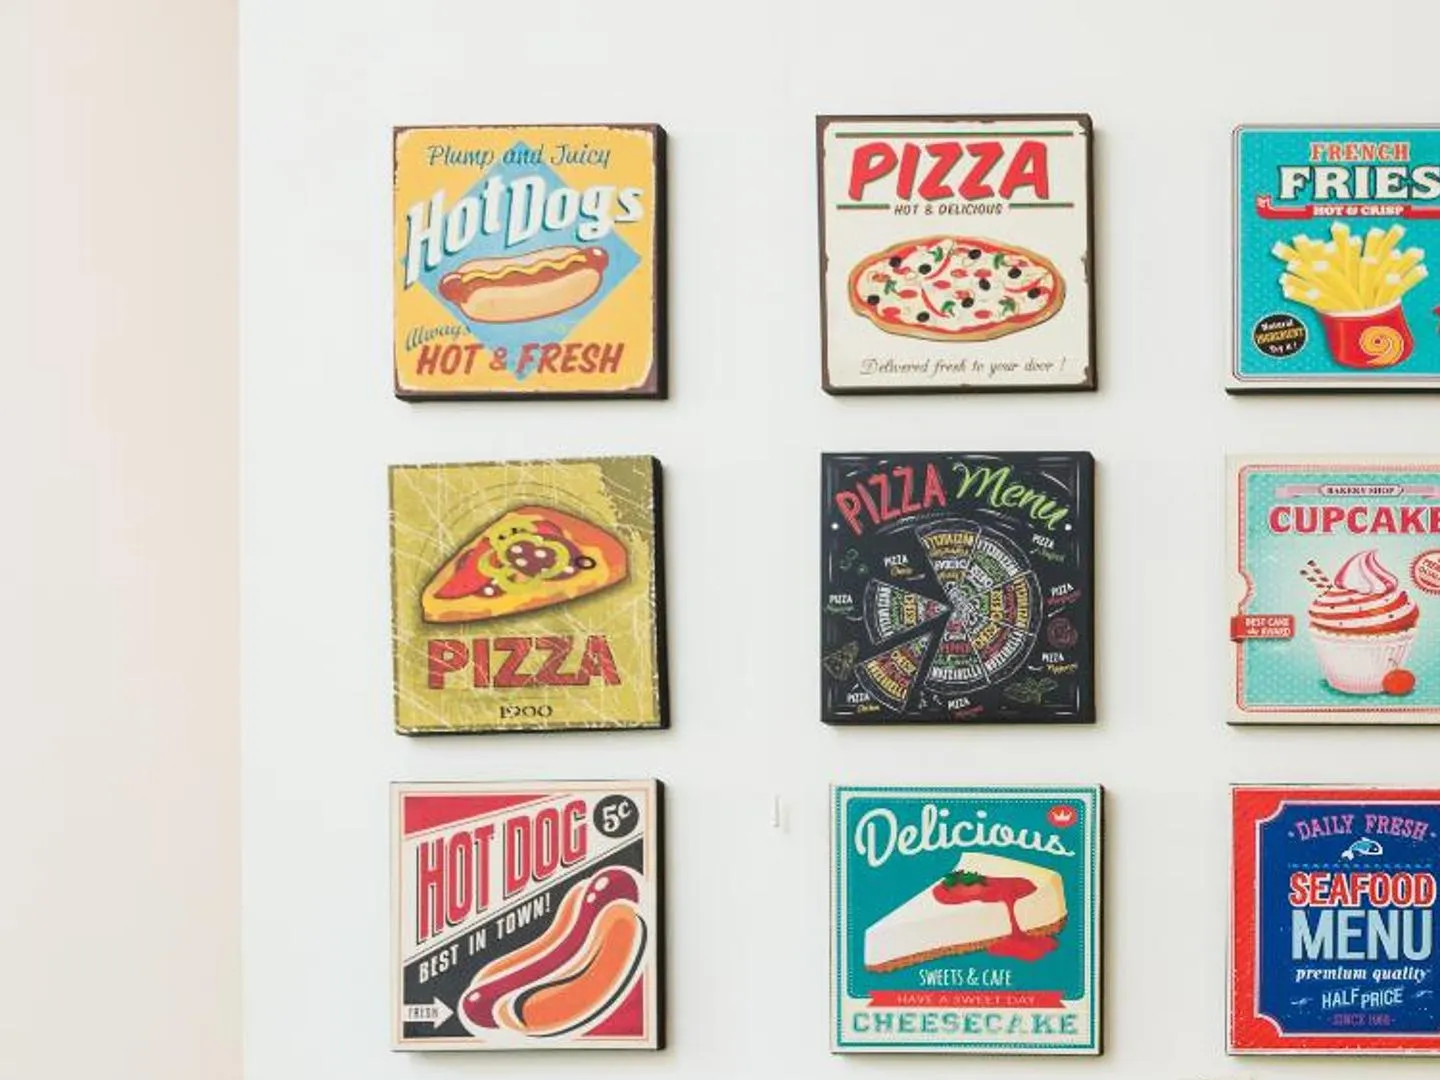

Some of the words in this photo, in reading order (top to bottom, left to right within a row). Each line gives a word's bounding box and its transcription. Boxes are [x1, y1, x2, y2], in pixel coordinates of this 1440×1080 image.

[428, 144, 494, 169] Plump
[503, 144, 544, 165] and
[551, 143, 611, 169] Juicy
[1310, 142, 1411, 162] FRENCH
[848, 140, 1050, 201] PIZZA
[894, 204, 919, 216] HOT
[925, 204, 933, 215] &
[938, 203, 1003, 216] DELICIOUS
[1313, 205, 1345, 216] HOT
[1347, 206, 1358, 215] &
[1361, 205, 1404, 216] CRISP
[416, 343, 484, 375] HOT
[489, 346, 507, 372] &
[516, 342, 624, 375] FRESH
[860, 358, 930, 375] Delivered
[930, 359, 966, 378] fresh
[971, 360, 984, 373] to
[988, 361, 1020, 378] your
[835, 463, 947, 536] PIZZA
[952, 461, 1071, 530] Menu
[1327, 486, 1366, 495] BAKERY
[1369, 486, 1395, 495] SHOP
[1245, 617, 1265, 627] BEST
[427, 635, 621, 690] PIZZA
[854, 804, 1075, 868] Delicious
[1296, 814, 1355, 840] DAILY
[1365, 814, 1429, 841] FRESH
[417, 824, 494, 945] HOT
[503, 799, 587, 899] DOG
[1288, 871, 1437, 908] SEAFOOD
[419, 947, 459, 984] BEST
[469, 931, 487, 956] IN
[496, 893, 551, 939] TOWN!
[1291, 910, 1433, 961] MENU
[919, 969, 962, 986] SWEETS
[963, 968, 979, 987] &
[1296, 965, 1366, 983] premium
[1372, 965, 1426, 983] quality
[898, 995, 932, 1004] HAVE
[953, 995, 1000, 1004] SWEET
[1006, 995, 1035, 1004] DAY
[1322, 988, 1360, 1009] HALF
[1361, 987, 1404, 1009] PRICE
[408, 1007, 439, 1019] FRESH
[854, 1012, 1078, 1034] CHEESECAKE
